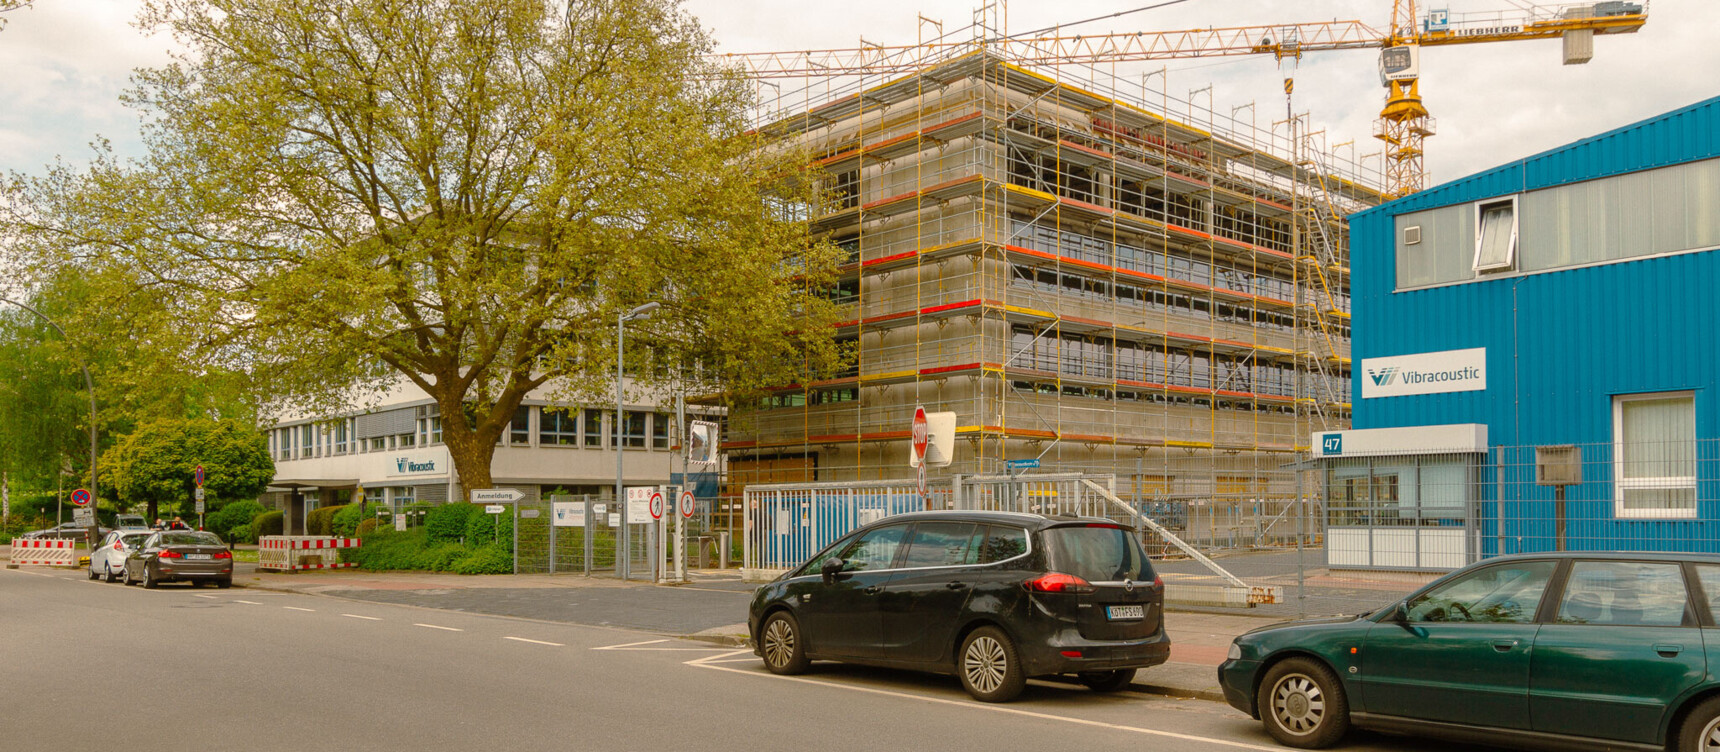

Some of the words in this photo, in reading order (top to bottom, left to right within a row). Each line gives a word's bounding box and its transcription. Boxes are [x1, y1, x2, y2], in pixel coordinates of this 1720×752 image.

[1458, 26, 1519, 35] LIEBHERR
[1402, 366, 1480, 384] Vibracoustic
[914, 423, 926, 444] STOP
[1324, 438, 1340, 450] 47
